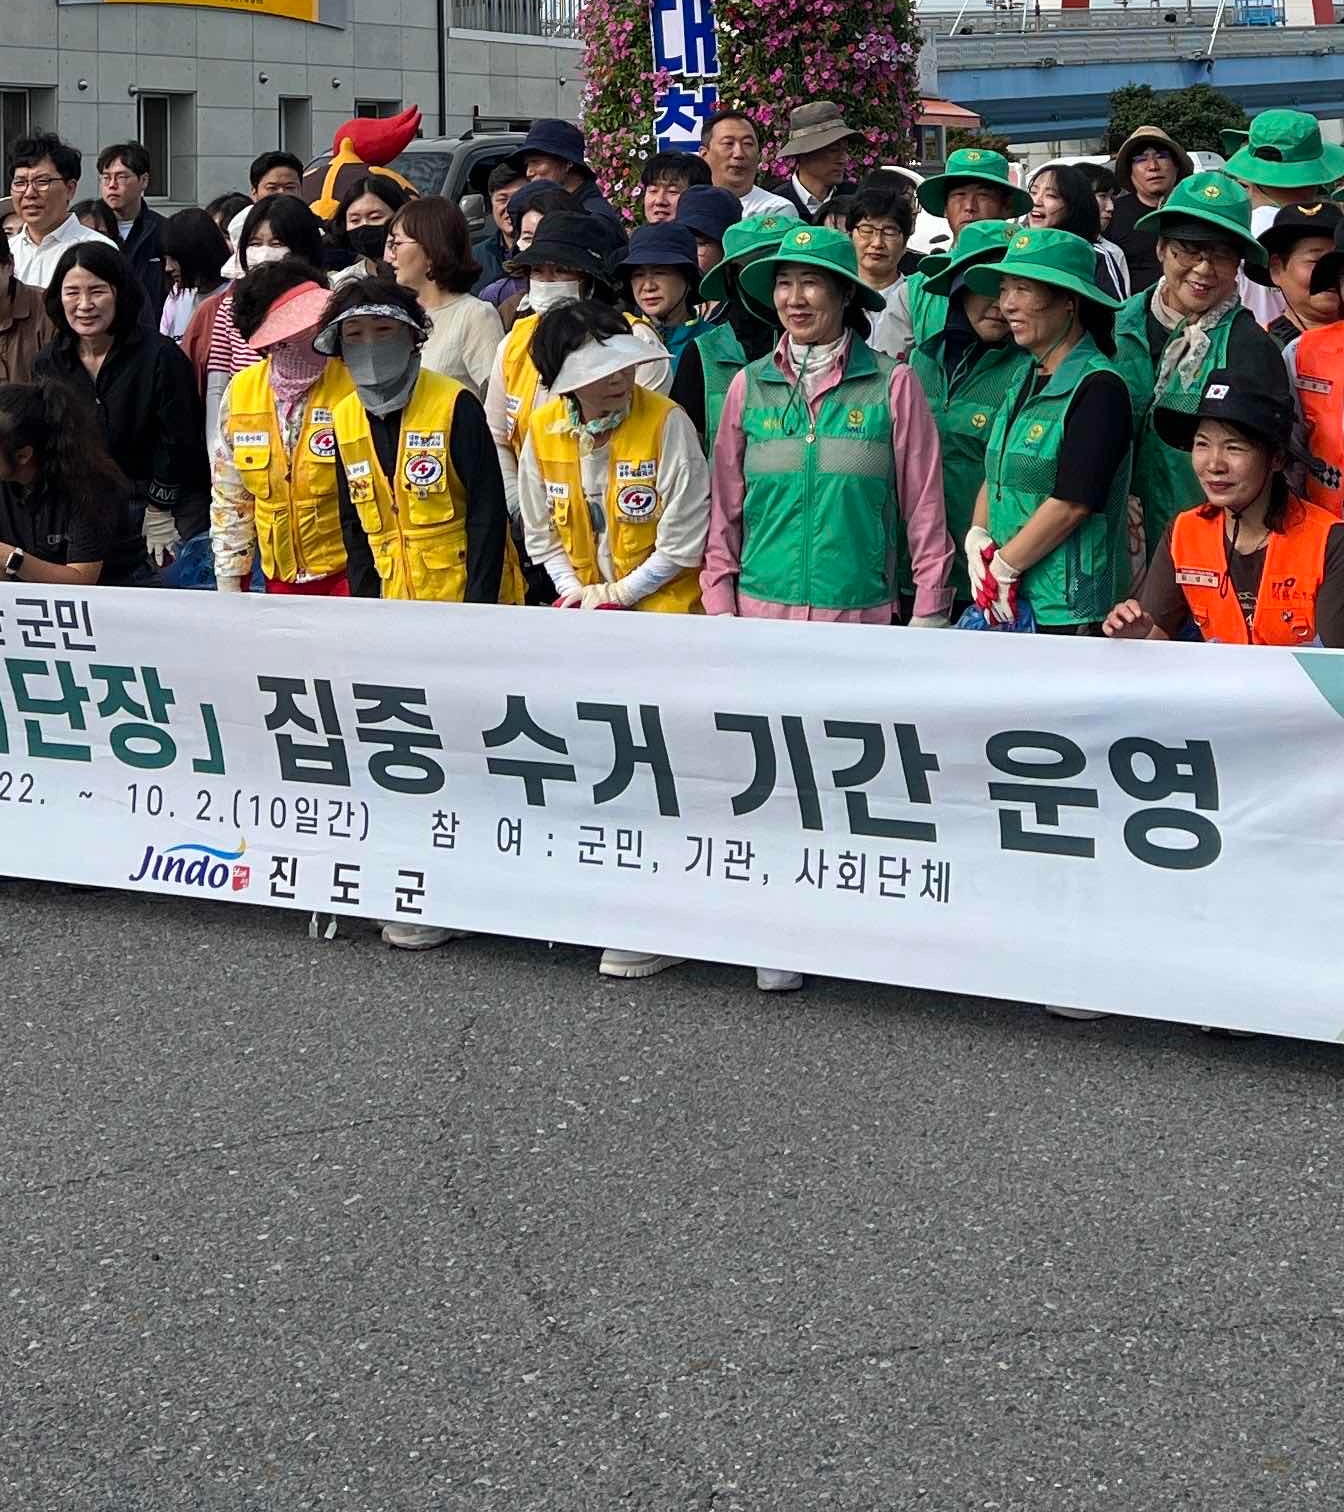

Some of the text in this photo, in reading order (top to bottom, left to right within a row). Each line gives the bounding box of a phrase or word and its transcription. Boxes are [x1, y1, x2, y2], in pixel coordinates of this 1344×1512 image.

[15, 597, 97, 652] 군민
[256, 674, 447, 795] 집중
[481, 694, 681, 818] 수거
[714, 711, 941, 843] 기간
[985, 729, 1223, 871] 운영
[127, 783, 176, 818] 10.
[578, 824, 658, 873] 군민,
[684, 834, 769, 886] 기관,
[795, 847, 951, 904] 사회단체
[129, 845, 229, 890] Jindo
